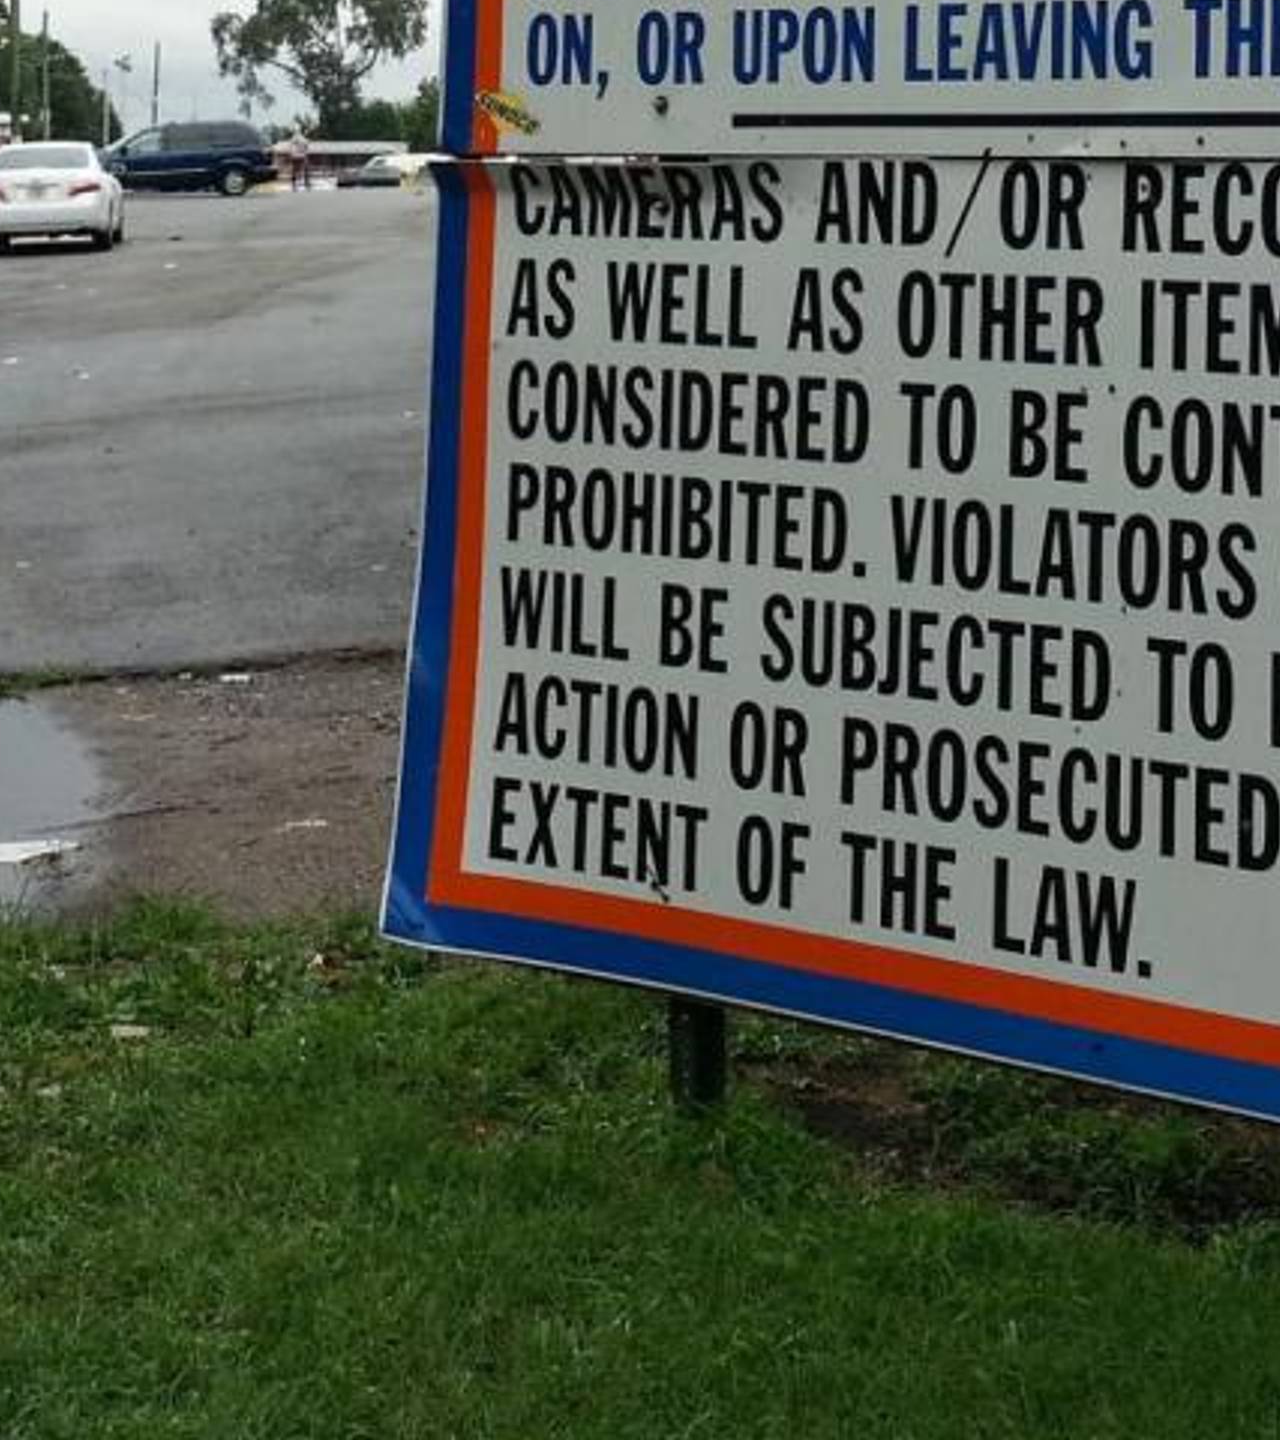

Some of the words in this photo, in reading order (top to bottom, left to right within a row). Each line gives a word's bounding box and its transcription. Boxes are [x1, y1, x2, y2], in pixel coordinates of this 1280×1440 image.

[527, 12, 609, 99] ON,
[637, 10, 705, 86] OR
[733, 6, 875, 85] UPON
[510, 162, 783, 242] CAMERAS
[815, 149, 1087, 255] AND/OR
[506, 258, 576, 340] AS
[606, 261, 757, 349] WELL
[787, 267, 864, 355] AS
[898, 270, 1104, 367] OTHER
[507, 358, 870, 464] CONSIDERED
[899, 381, 977, 474] TO
[1009, 387, 1088, 484] BE
[506, 462, 866, 578] PROHIBITED.
[890, 494, 1257, 620] VIOLATORS
[500, 565, 629, 661] WILL
[659, 582, 729, 674] BE
[760, 593, 1111, 722] SUBJECTED
[1147, 636, 1234, 742] TO
[493, 672, 699, 781] ACTION
[730, 700, 808, 798] OR
[840, 716, 1280, 872] PROSECUTED
[488, 777, 708, 892] EXTENT
[736, 814, 811, 911] OF
[840, 831, 956, 942] THE
[992, 856, 1152, 979] LAW.
